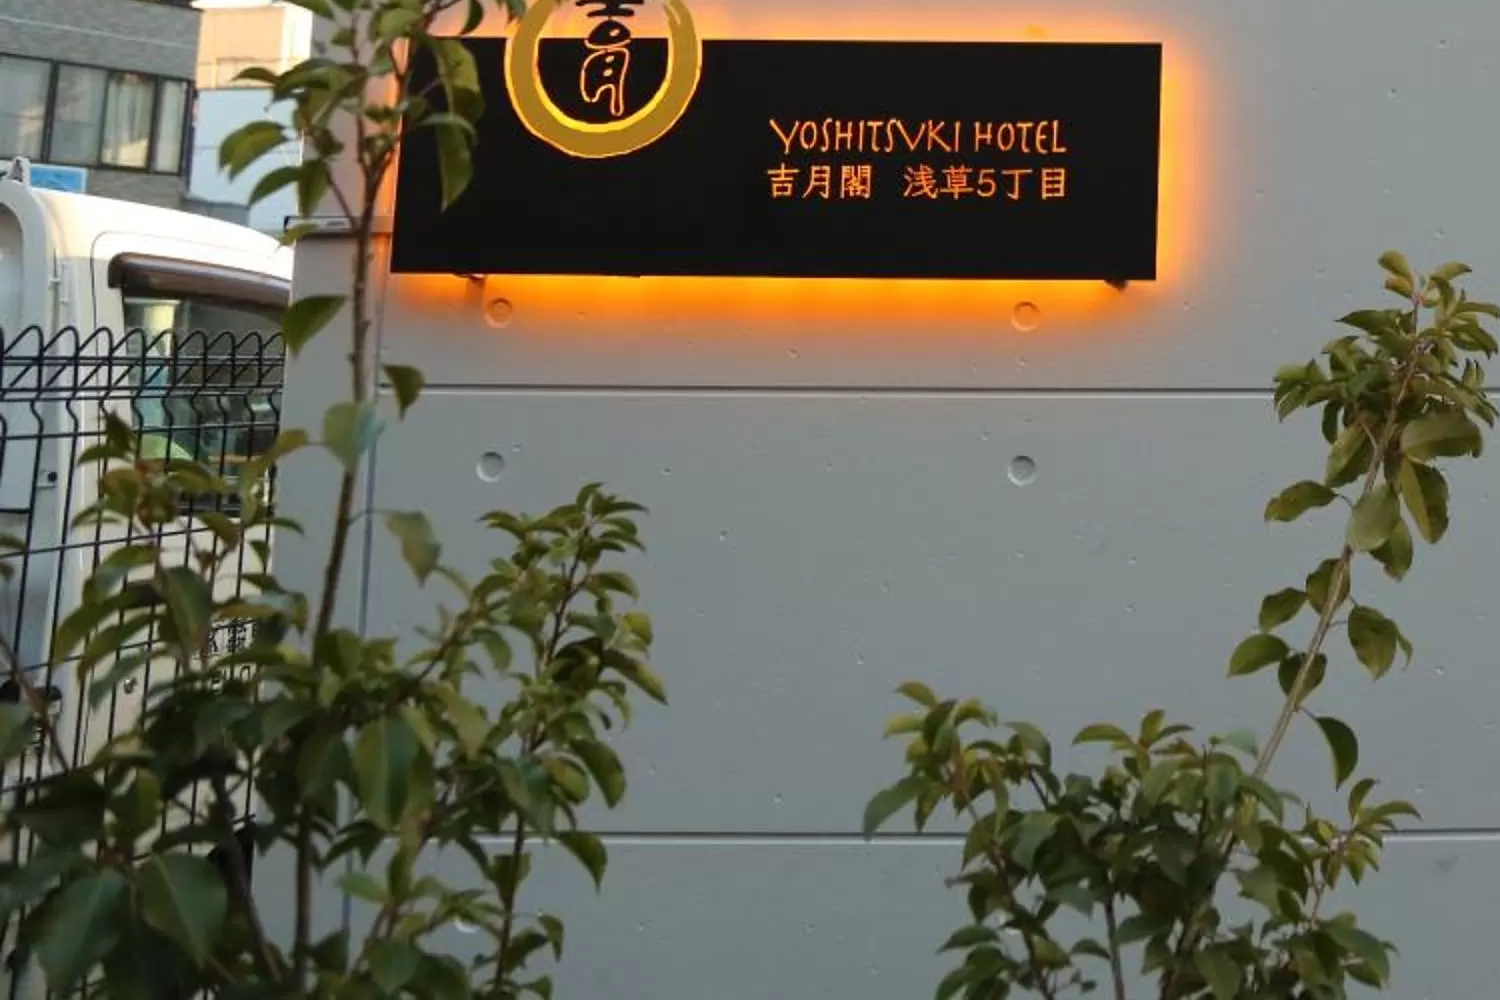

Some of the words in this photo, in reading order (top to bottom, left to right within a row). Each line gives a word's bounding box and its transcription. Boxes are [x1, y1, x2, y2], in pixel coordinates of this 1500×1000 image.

[973, 120, 1068, 154] HOTEL
[767, 163, 873, 199] 吉月閣
[903, 164, 1068, 201] 浅草5丁目
